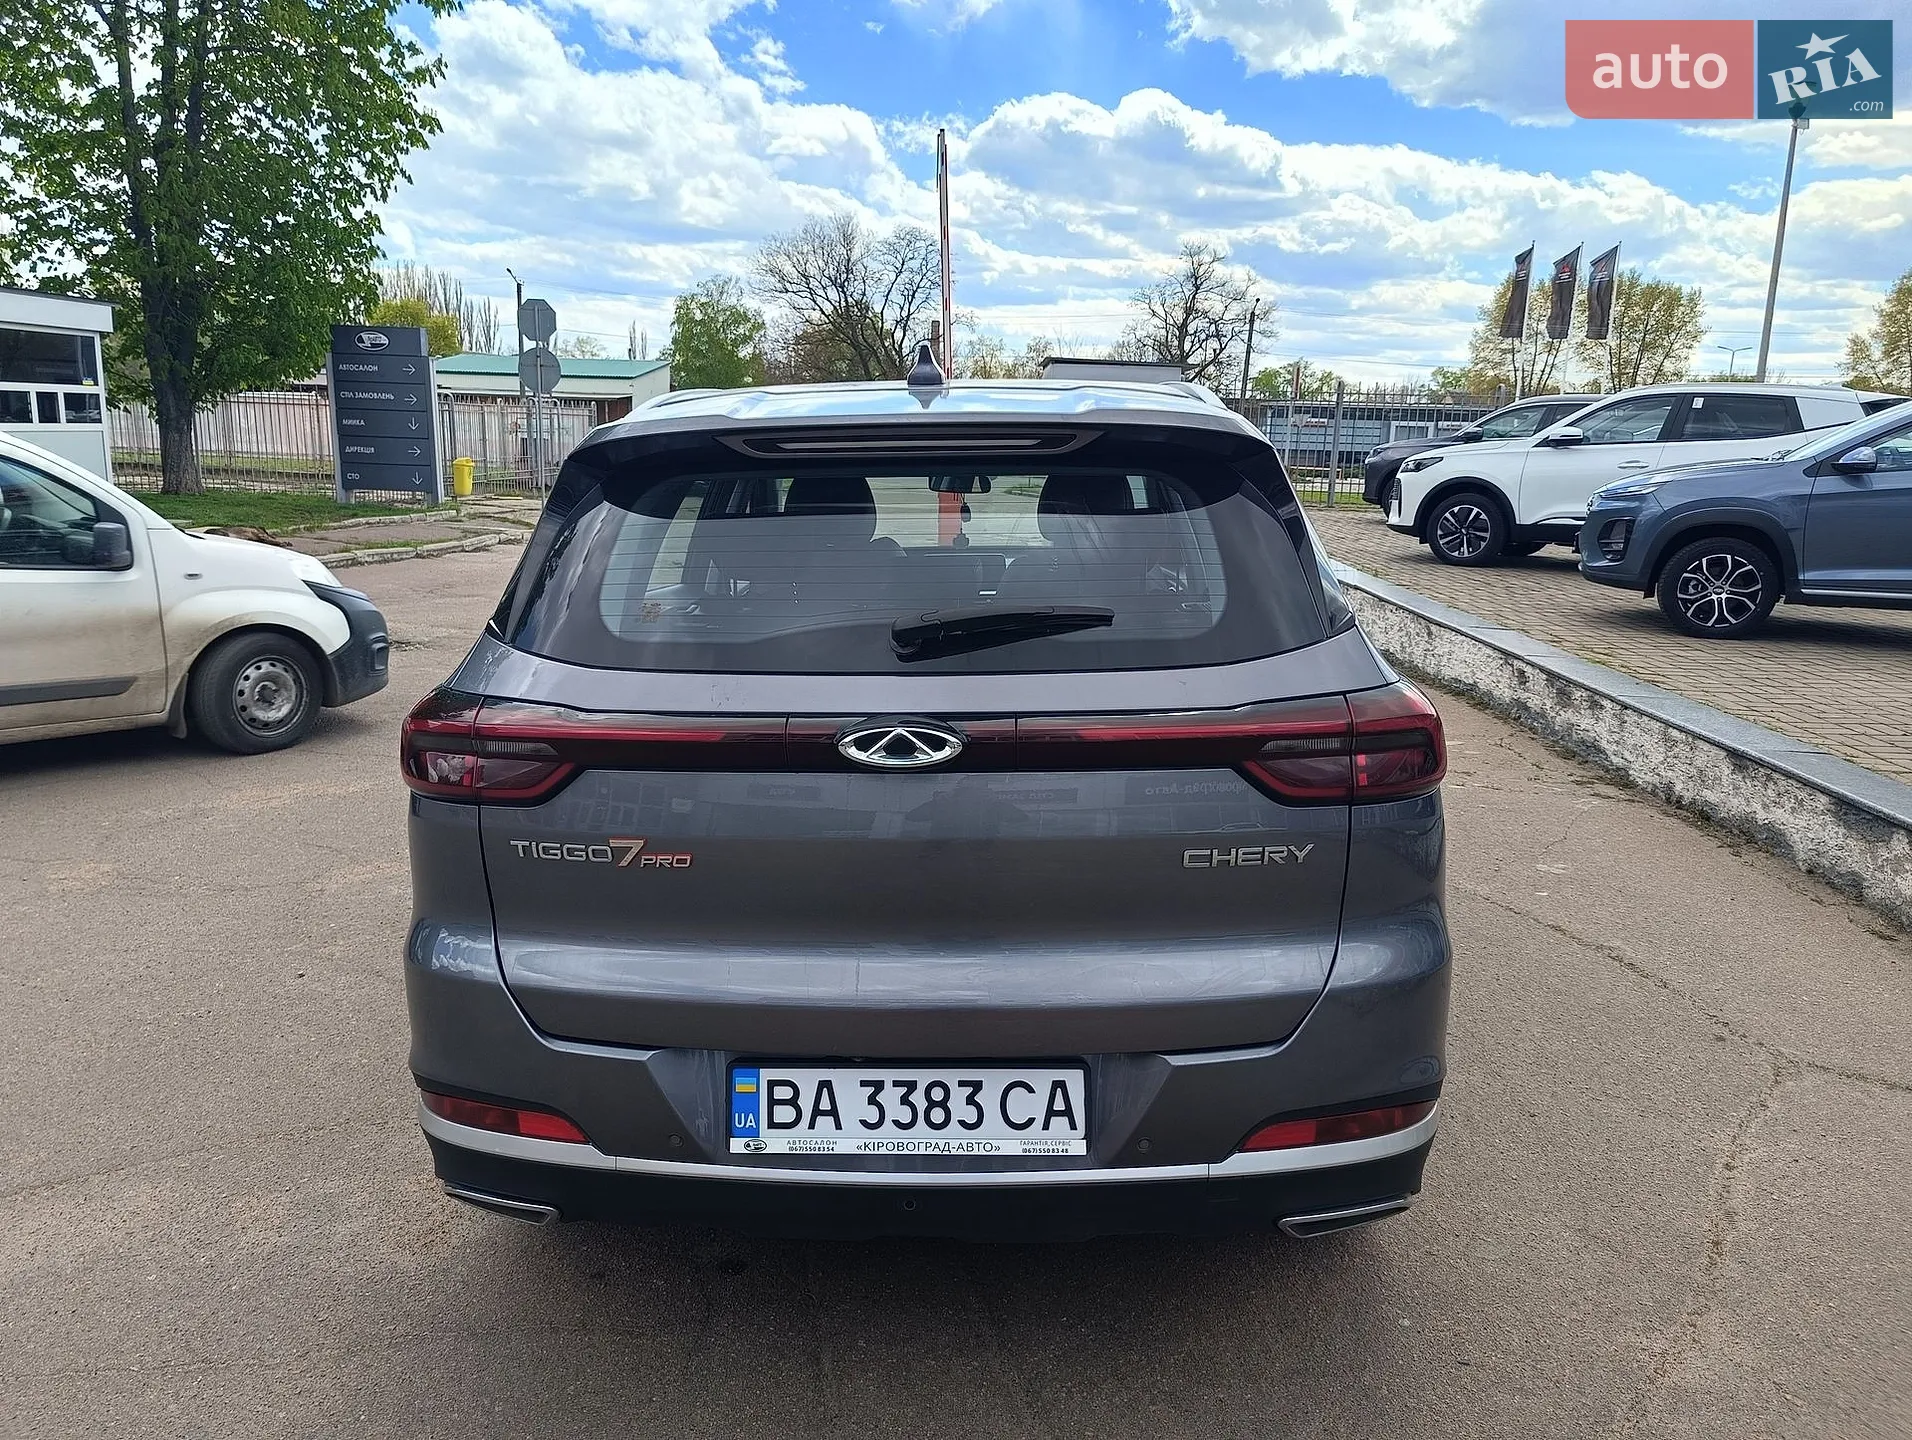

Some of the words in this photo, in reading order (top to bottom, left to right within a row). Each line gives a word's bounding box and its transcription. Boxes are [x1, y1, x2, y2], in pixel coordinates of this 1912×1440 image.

[338, 364, 379, 372] АВТОСАЛОН
[354, 391, 395, 400] ЗАМОВЛЕНЬ
[345, 445, 375, 454] ДИРЕКЦІЯ
[346, 472, 360, 480] СТО
[1183, 843, 1315, 868] CHERY
[735, 1112, 756, 1128] UA
[766, 1079, 843, 1131] BA
[858, 1079, 985, 1131] 3383
[999, 1080, 1078, 1131] CA
